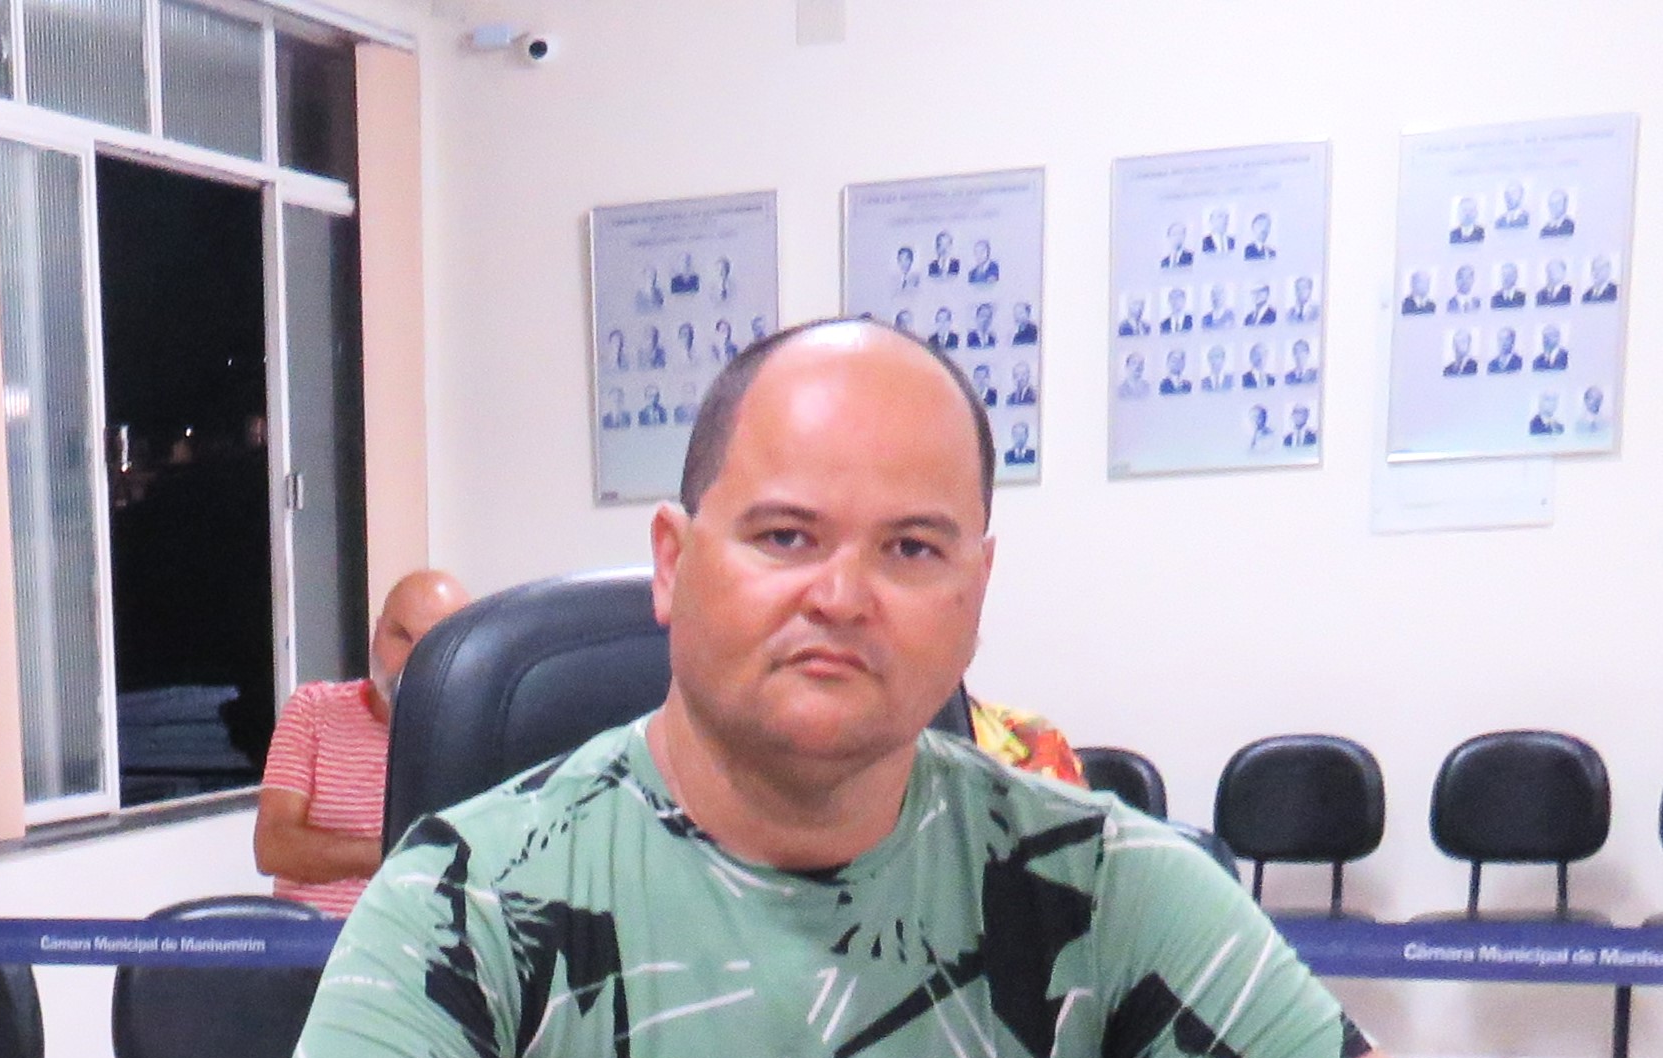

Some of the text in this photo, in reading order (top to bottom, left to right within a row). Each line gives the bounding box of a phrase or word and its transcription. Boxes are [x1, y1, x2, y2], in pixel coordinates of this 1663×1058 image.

[93, 936, 158, 953] Municipal
[161, 938, 178, 951] de
[180, 937, 265, 954] Manhumirim
[1403, 942, 1475, 962] Câmara
[1477, 945, 1569, 966] Municipal
[1571, 949, 1595, 964] de
